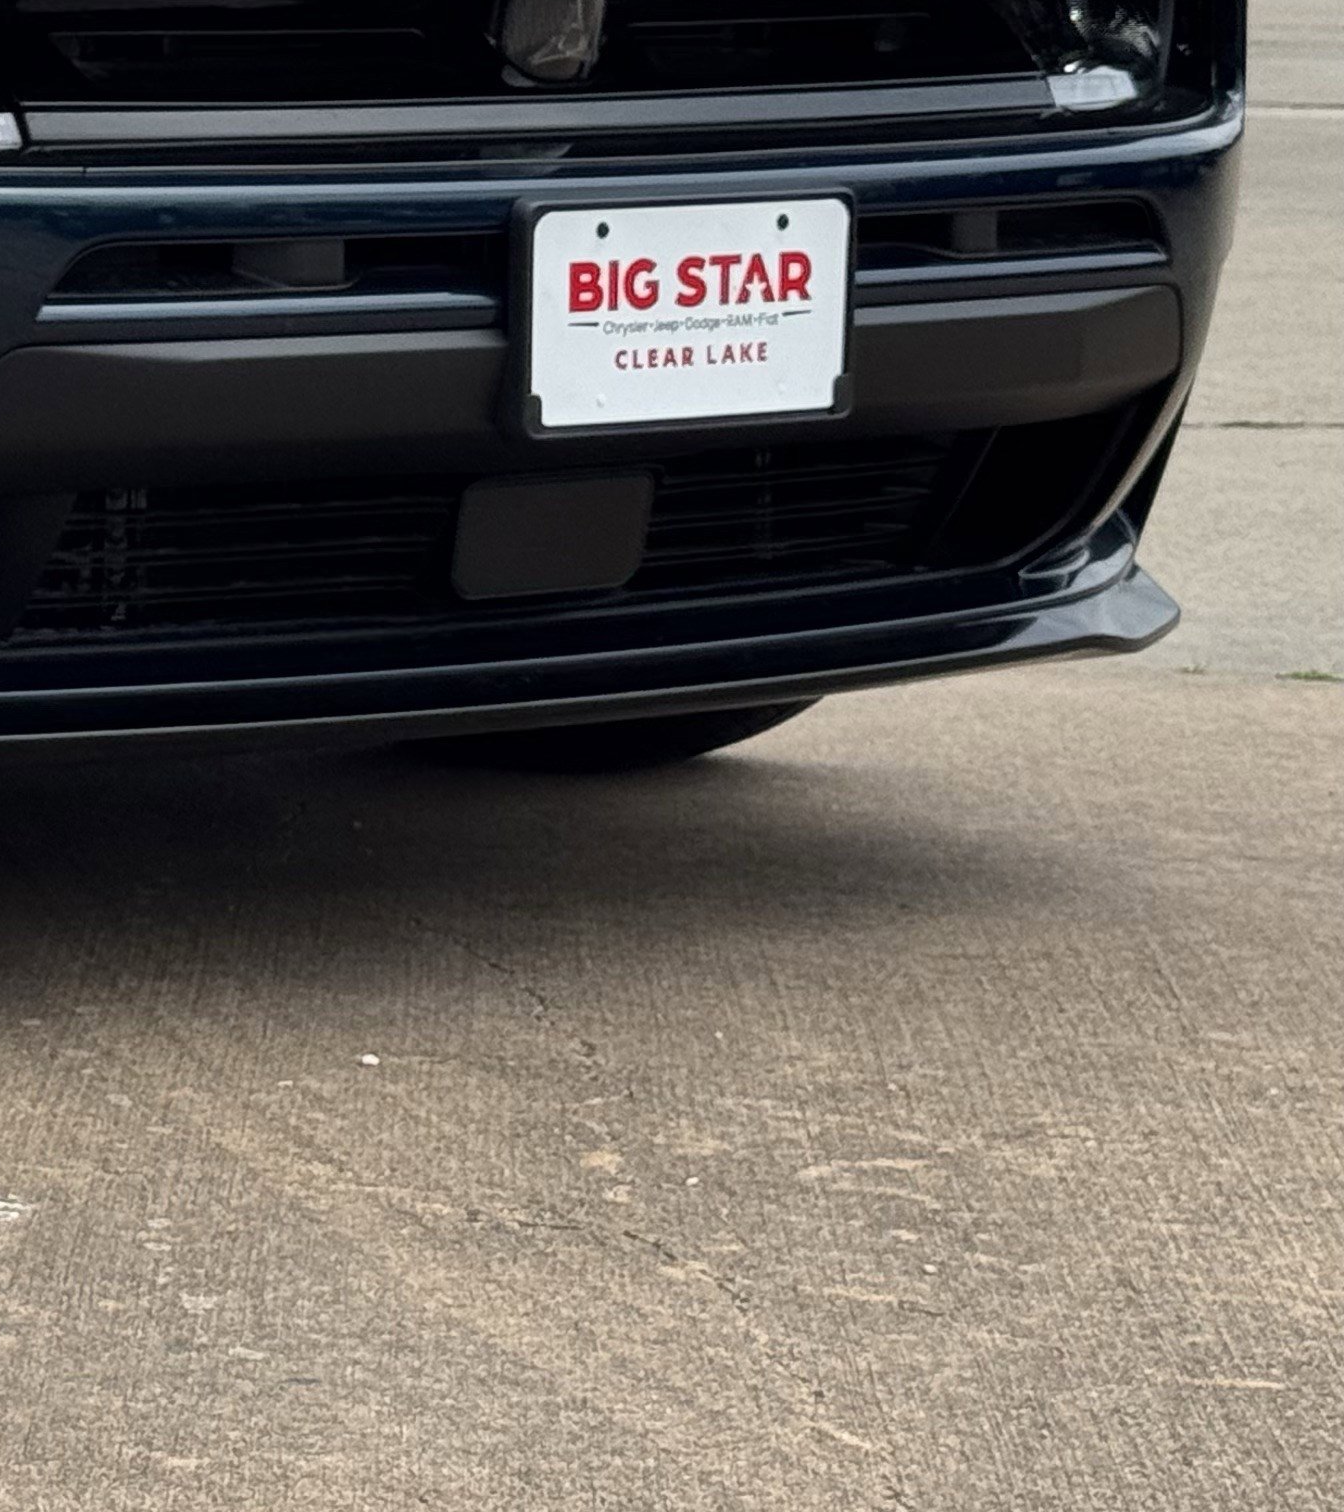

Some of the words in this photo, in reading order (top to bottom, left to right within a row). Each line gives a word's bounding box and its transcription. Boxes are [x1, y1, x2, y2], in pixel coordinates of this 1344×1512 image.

[569, 258, 660, 312] BIG
[675, 251, 812, 306] STAR
[615, 346, 694, 370] CLEAR
[706, 341, 769, 367] LAKE
